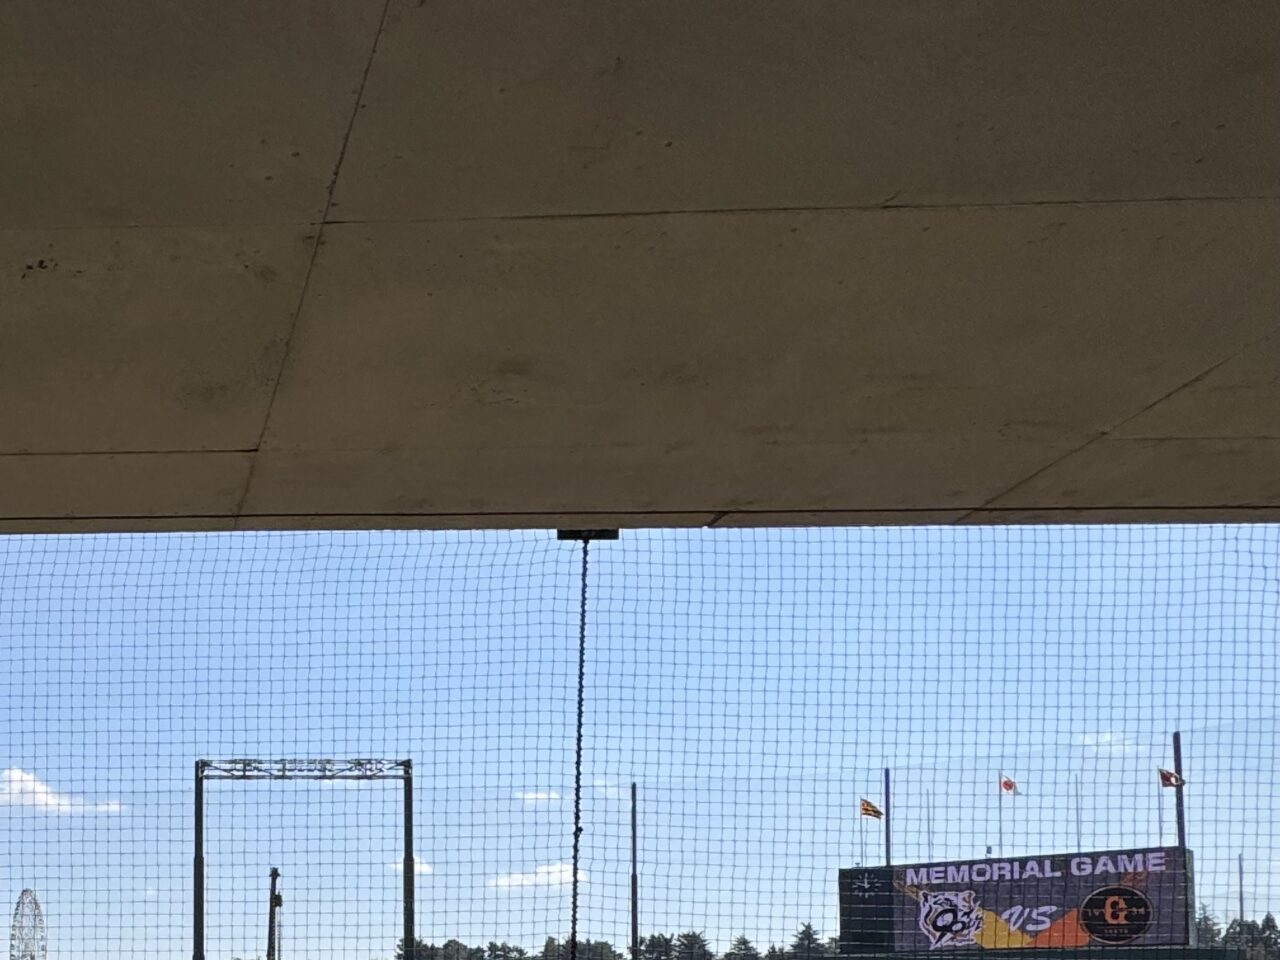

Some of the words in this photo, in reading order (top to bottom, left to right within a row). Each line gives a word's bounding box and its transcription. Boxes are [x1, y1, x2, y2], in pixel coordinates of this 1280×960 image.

[906, 859, 1062, 886] MEMORIAL
[1070, 852, 1166, 876] GAME
[1001, 904, 1058, 932] VS
